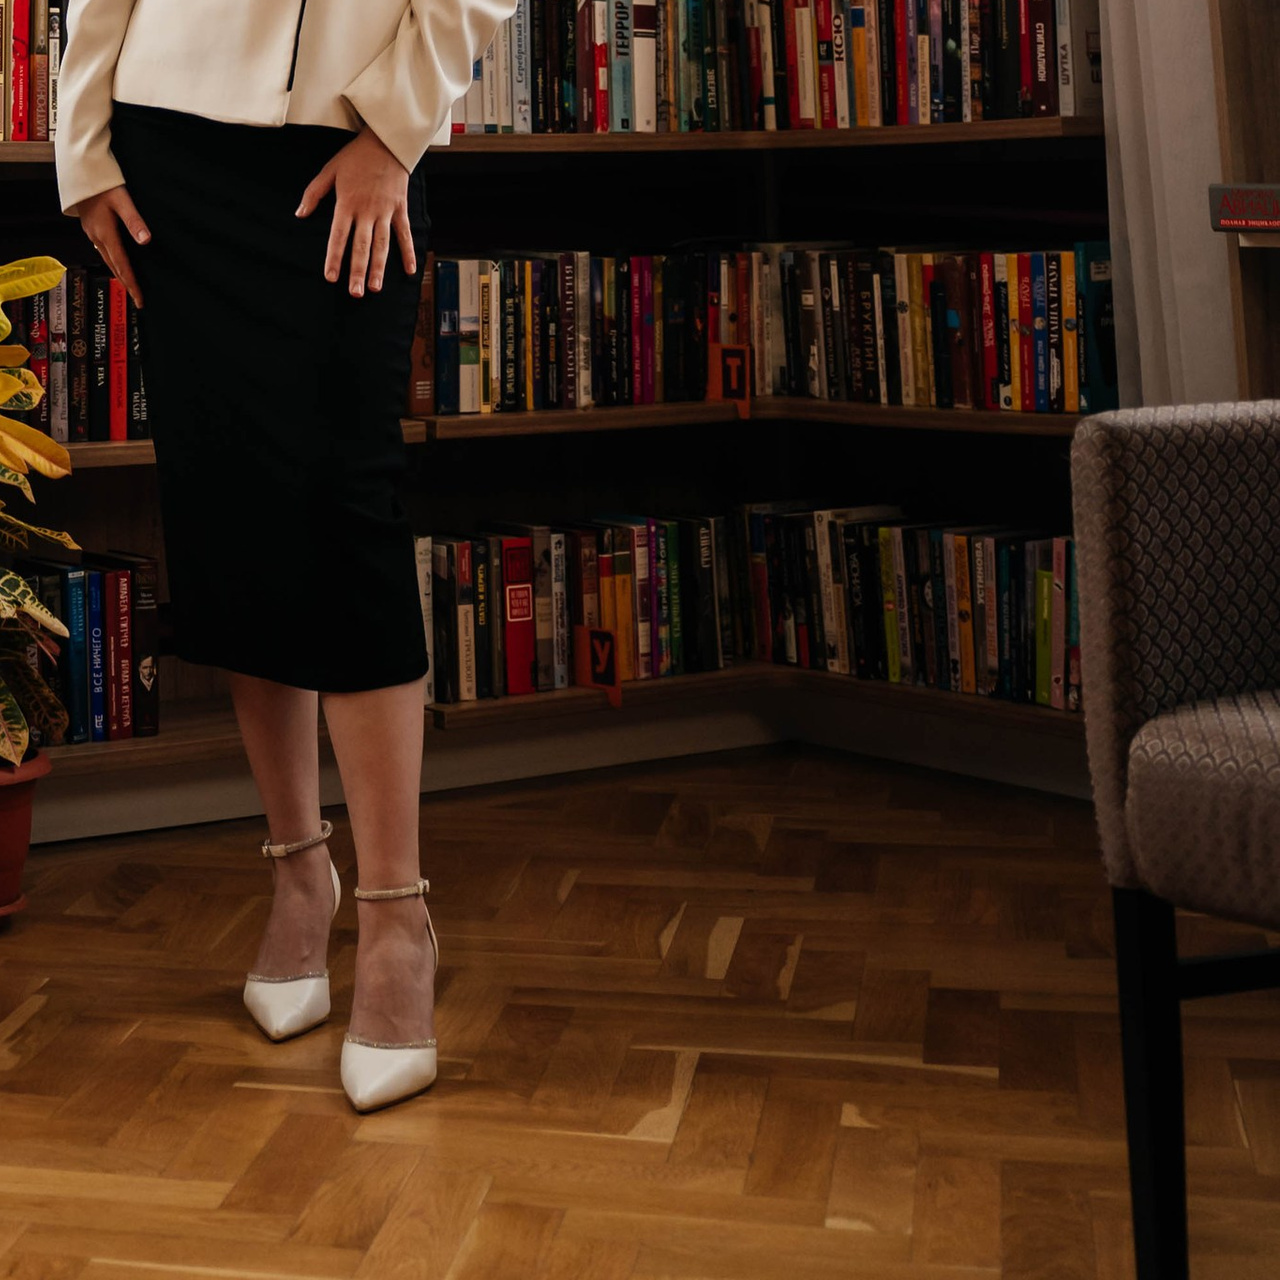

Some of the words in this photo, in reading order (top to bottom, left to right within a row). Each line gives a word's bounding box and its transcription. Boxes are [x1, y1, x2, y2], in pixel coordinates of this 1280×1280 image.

[616, 0, 630, 60] ТЕРРОР
[834, 14, 844, 62] КСЮ
[516, 23, 524, 84] Серебряный
[1060, 43, 1069, 86] ШУТКА
[72, 277, 82, 308] ДЮМА
[1022, 277, 1030, 309] ТРАУБ
[1036, 274, 1045, 308] ТРАУБ
[1050, 260, 1059, 300] ТРАУБ
[72, 310, 82, 335] КЛУБ
[861, 290, 873, 372] БРУКЛИН
[1050, 302, 1060, 344] МАША
[96, 367, 104, 387] ЕВА
[726, 358, 742, 390] Т
[478, 564, 486, 598] ВЕРИТЬ
[976, 542, 985, 604] УСТИНОВА
[92, 628, 103, 670] НИЧЕГО
[592, 640, 610, 682] У
[93, 673, 104, 694] ВСЕ
